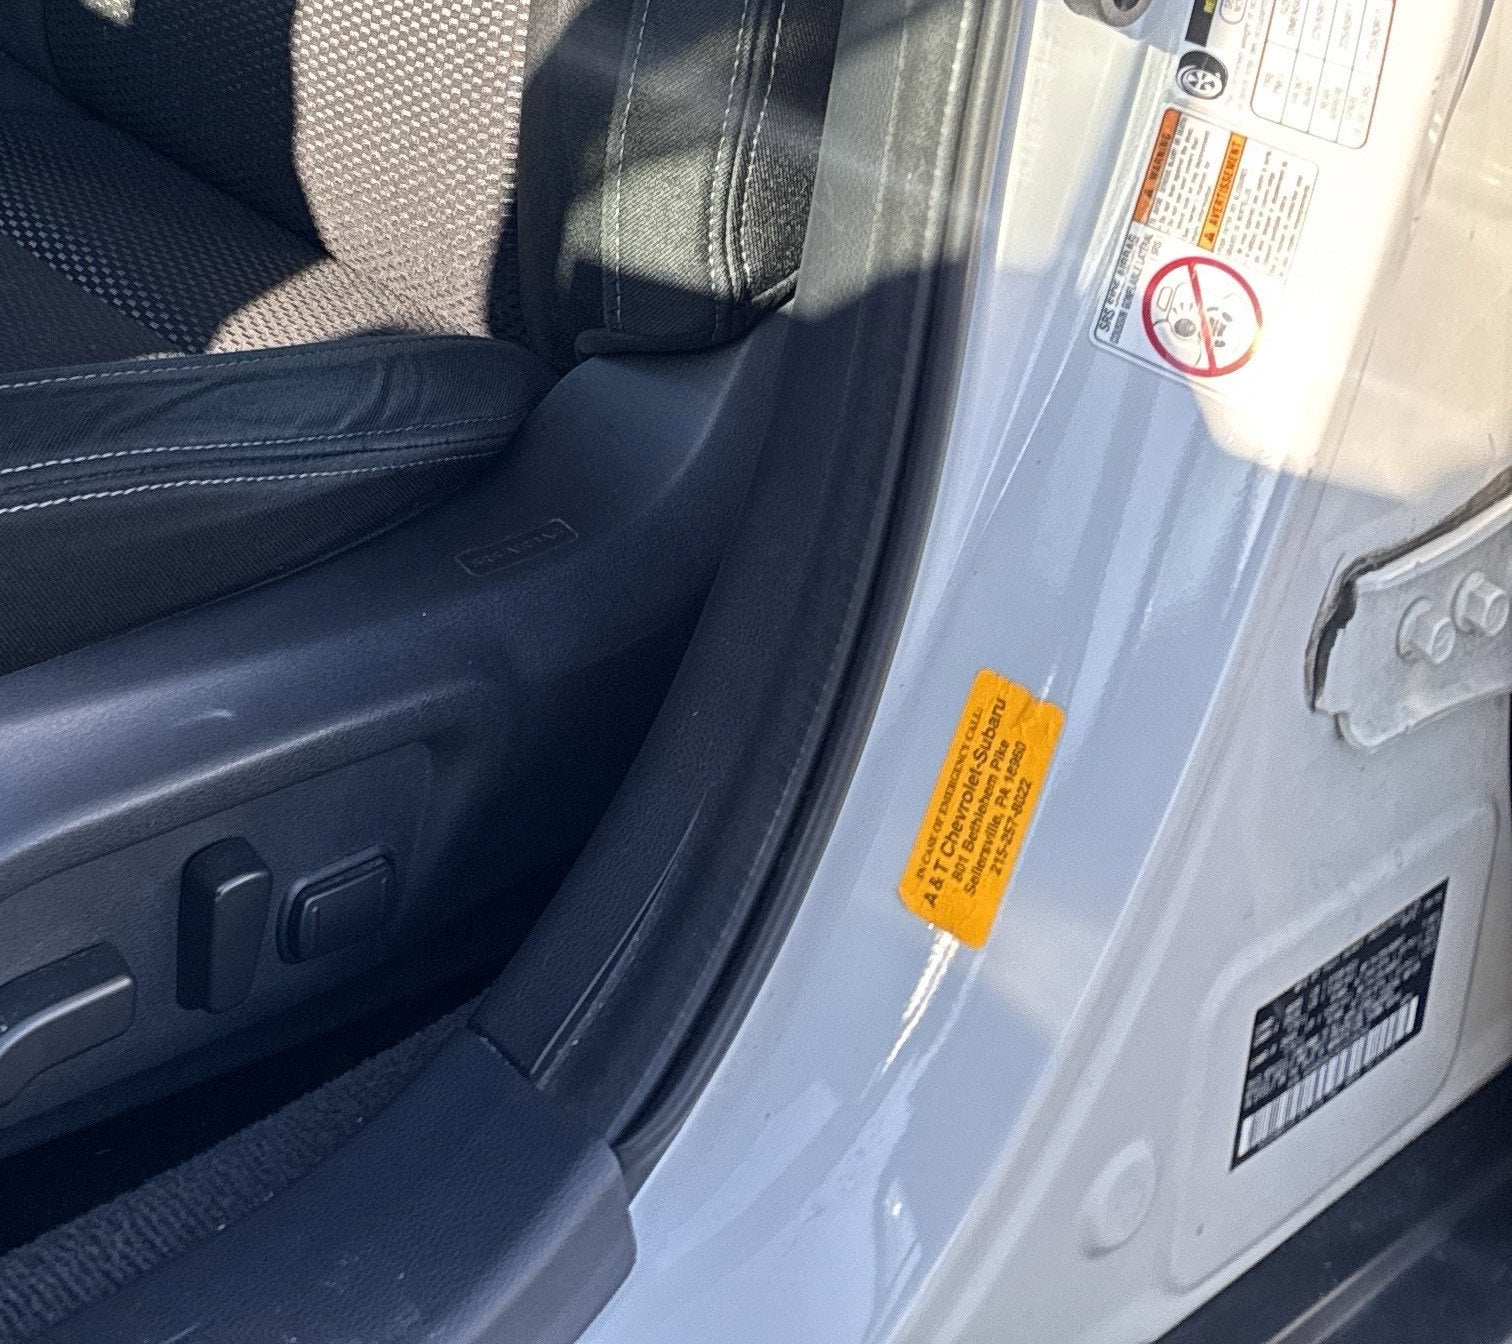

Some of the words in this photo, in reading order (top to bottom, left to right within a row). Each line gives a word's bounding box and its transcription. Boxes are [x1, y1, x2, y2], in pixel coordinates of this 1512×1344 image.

[1148, 133, 1171, 180] WARNING
[1210, 141, 1244, 226] AVERTISSEMENT
[1097, 307, 1115, 332] SRS
[940, 698, 1005, 856] Chevrolet-Subaru
[961, 774, 997, 852] Bethlehem
[989, 739, 1009, 771] Pike
[921, 833, 937, 865] CASE
[932, 814, 944, 833] OF
[963, 814, 1003, 895] Sellersville,
[994, 787, 1011, 808] PA
[928, 876, 944, 890] &
[933, 857, 948, 873] T
[923, 892, 938, 908] A
